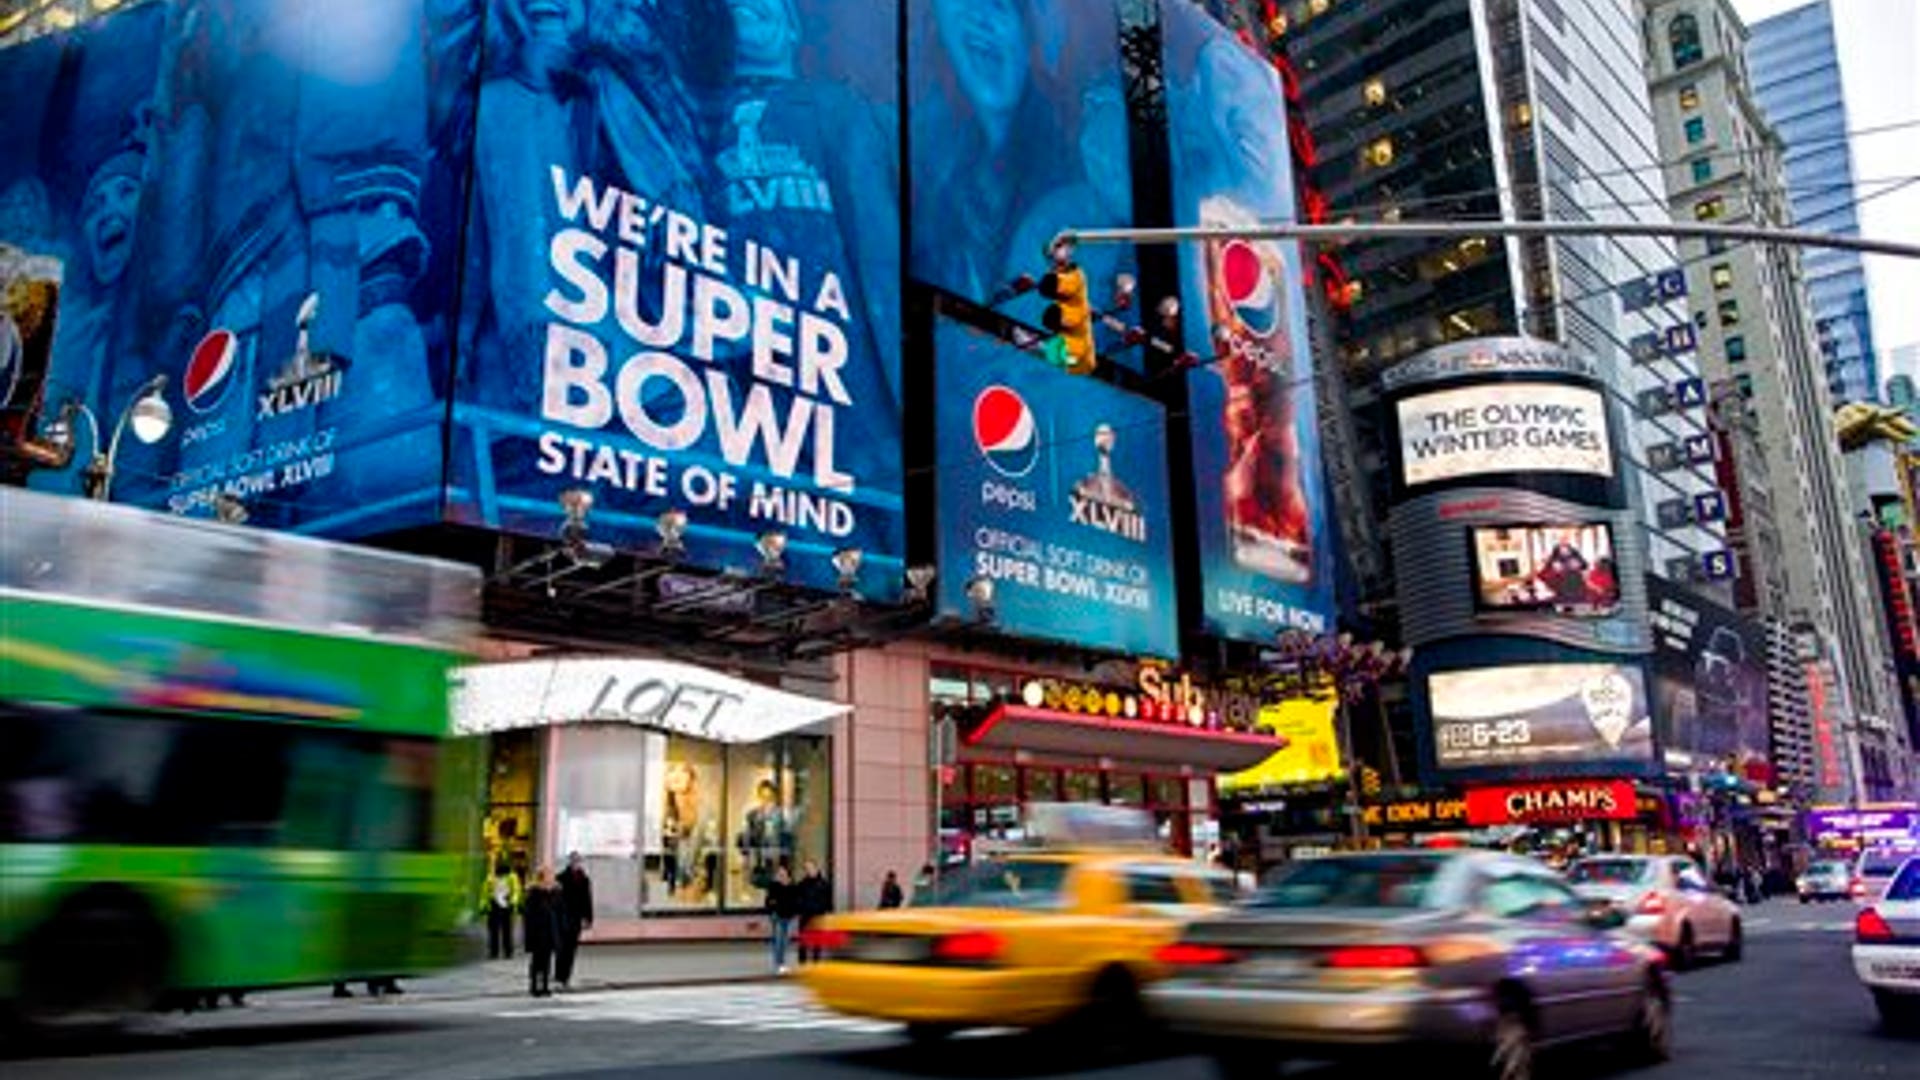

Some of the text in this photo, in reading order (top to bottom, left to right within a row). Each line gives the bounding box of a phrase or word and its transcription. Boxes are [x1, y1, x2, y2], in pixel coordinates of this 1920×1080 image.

[550, 164, 851, 321] WE'RE IN A
[543, 228, 852, 406] SUPER
[542, 322, 855, 494] BOWL
[1425, 403, 1587, 433] THE OLYMPIC
[1411, 427, 1602, 459] WINTER GAMES
[537, 429, 855, 537] STATE OF MIND
[981, 481, 1036, 511] pepsi
[1068, 494, 1146, 542] XLVIII
[975, 550, 1041, 588] SUPER
[1043, 566, 1100, 602] BOWL
[1047, 543, 1083, 570] SOFT
[1218, 587, 1325, 634] LIVE FOR NOW
[589, 675, 744, 731] LOFT
[1506, 788, 1618, 817] CHAMPS
